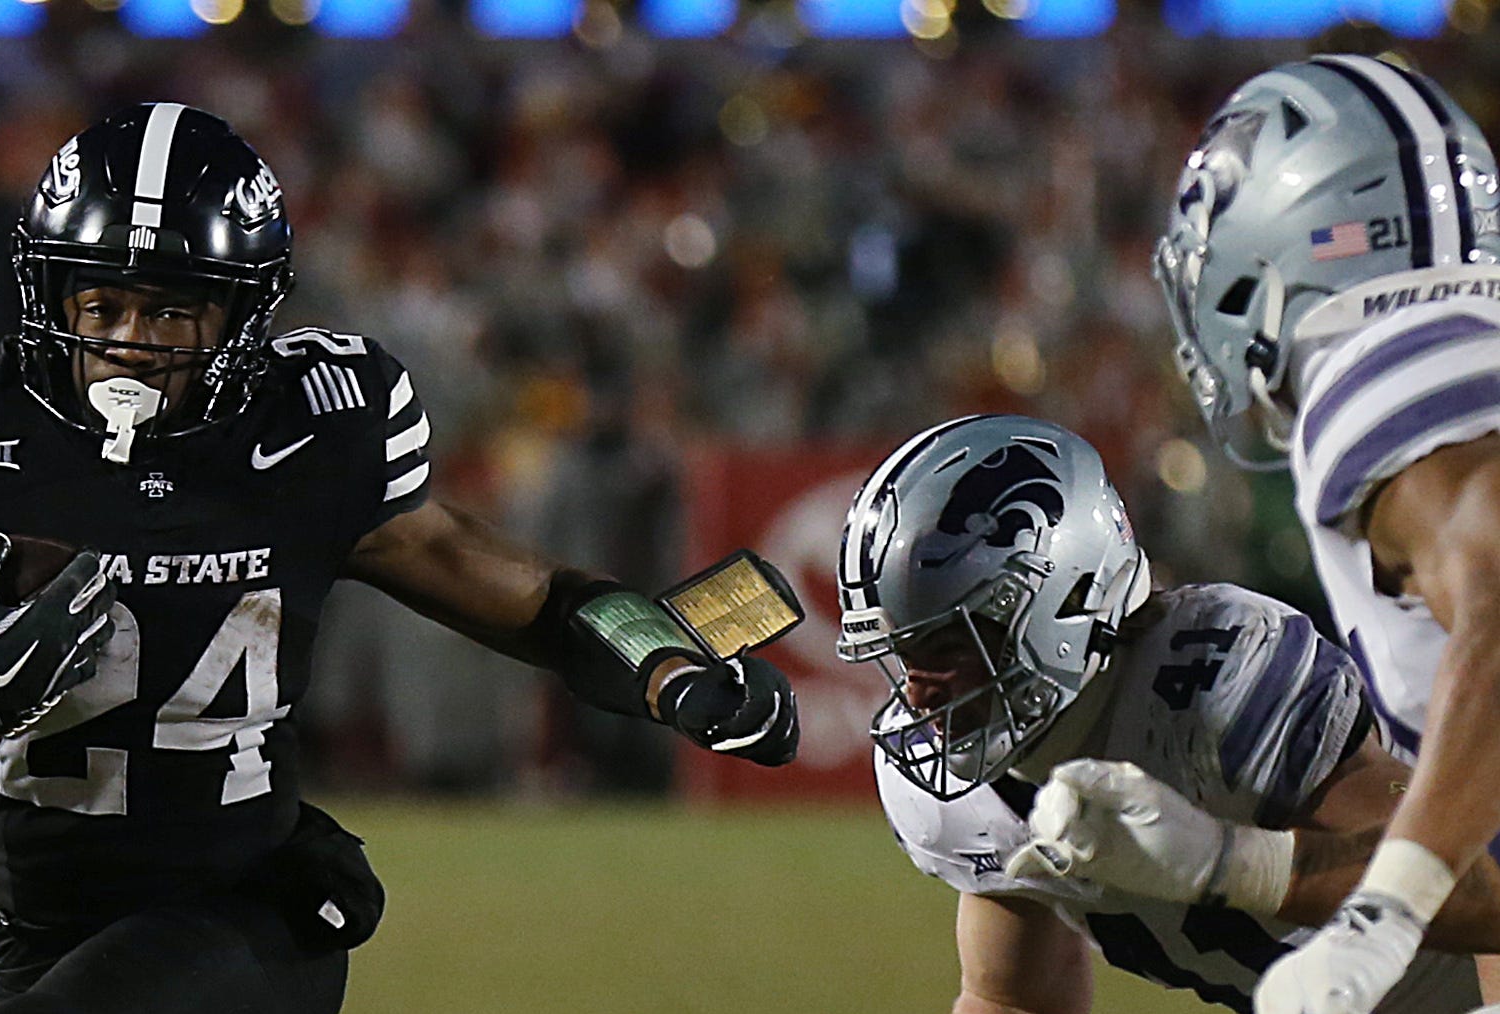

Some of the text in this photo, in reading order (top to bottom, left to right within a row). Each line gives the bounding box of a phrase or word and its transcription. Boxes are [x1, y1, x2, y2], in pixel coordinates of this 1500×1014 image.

[1368, 214, 1409, 251] 21
[1362, 279, 1500, 318] WILDCAT
[144, 547, 272, 585] STATE
[1152, 624, 1247, 712] 41
